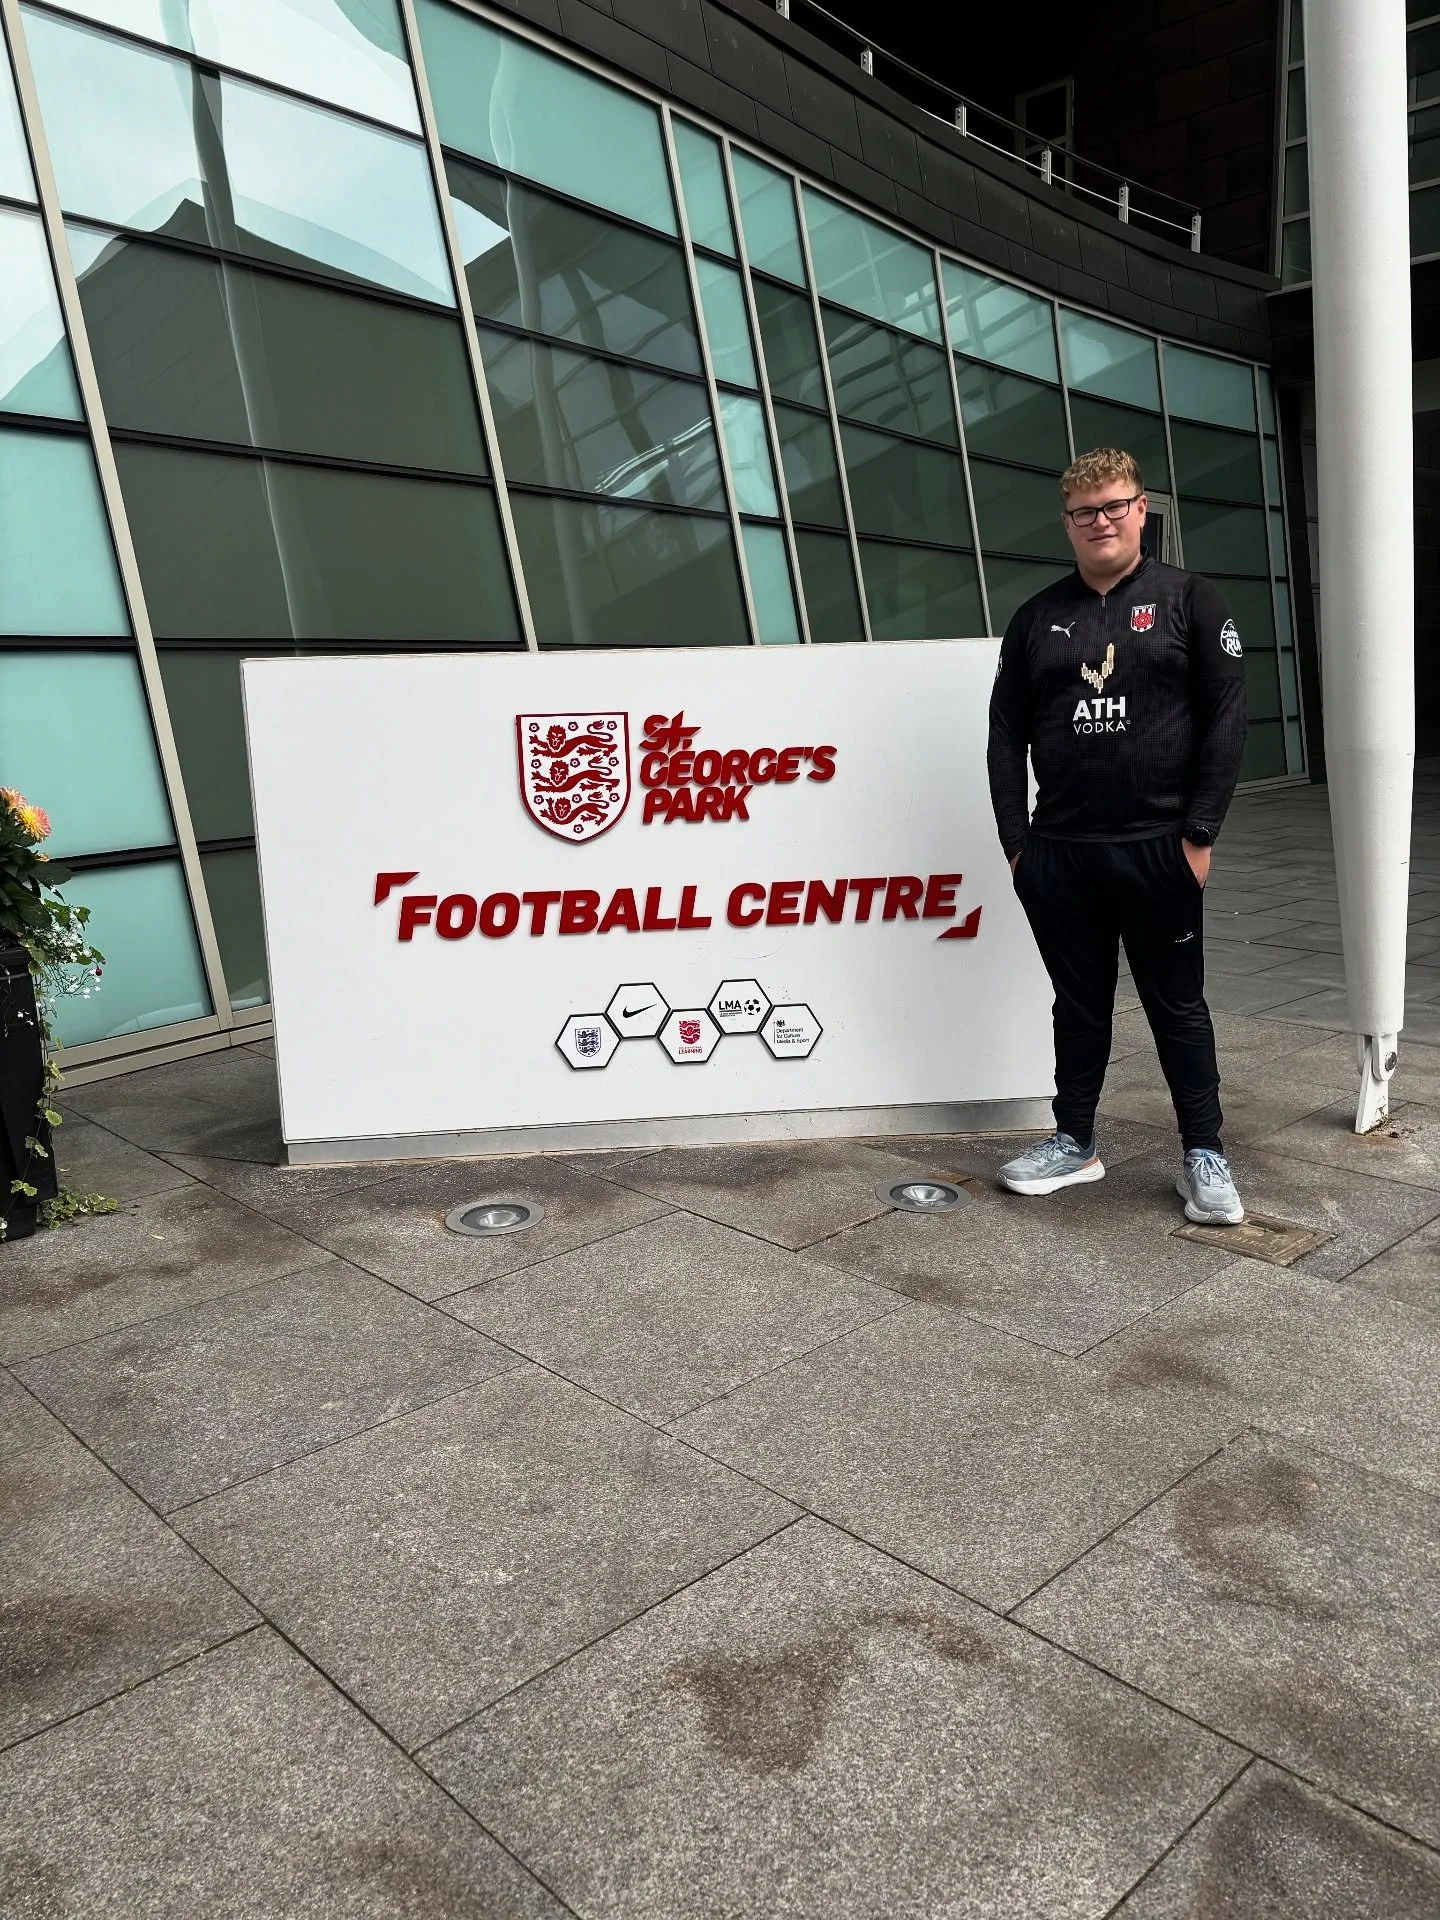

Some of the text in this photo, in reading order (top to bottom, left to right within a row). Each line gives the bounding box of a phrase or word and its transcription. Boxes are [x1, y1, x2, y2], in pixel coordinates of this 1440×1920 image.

[1072, 696, 1126, 721] ATH
[1073, 720, 1126, 735] VODKA
[639, 710, 702, 754] St.
[639, 745, 837, 787] GEORGE'S
[642, 784, 753, 824] PARK
[398, 873, 963, 941] FOOTBALL CENTRE
[718, 999, 742, 1011] LMA
